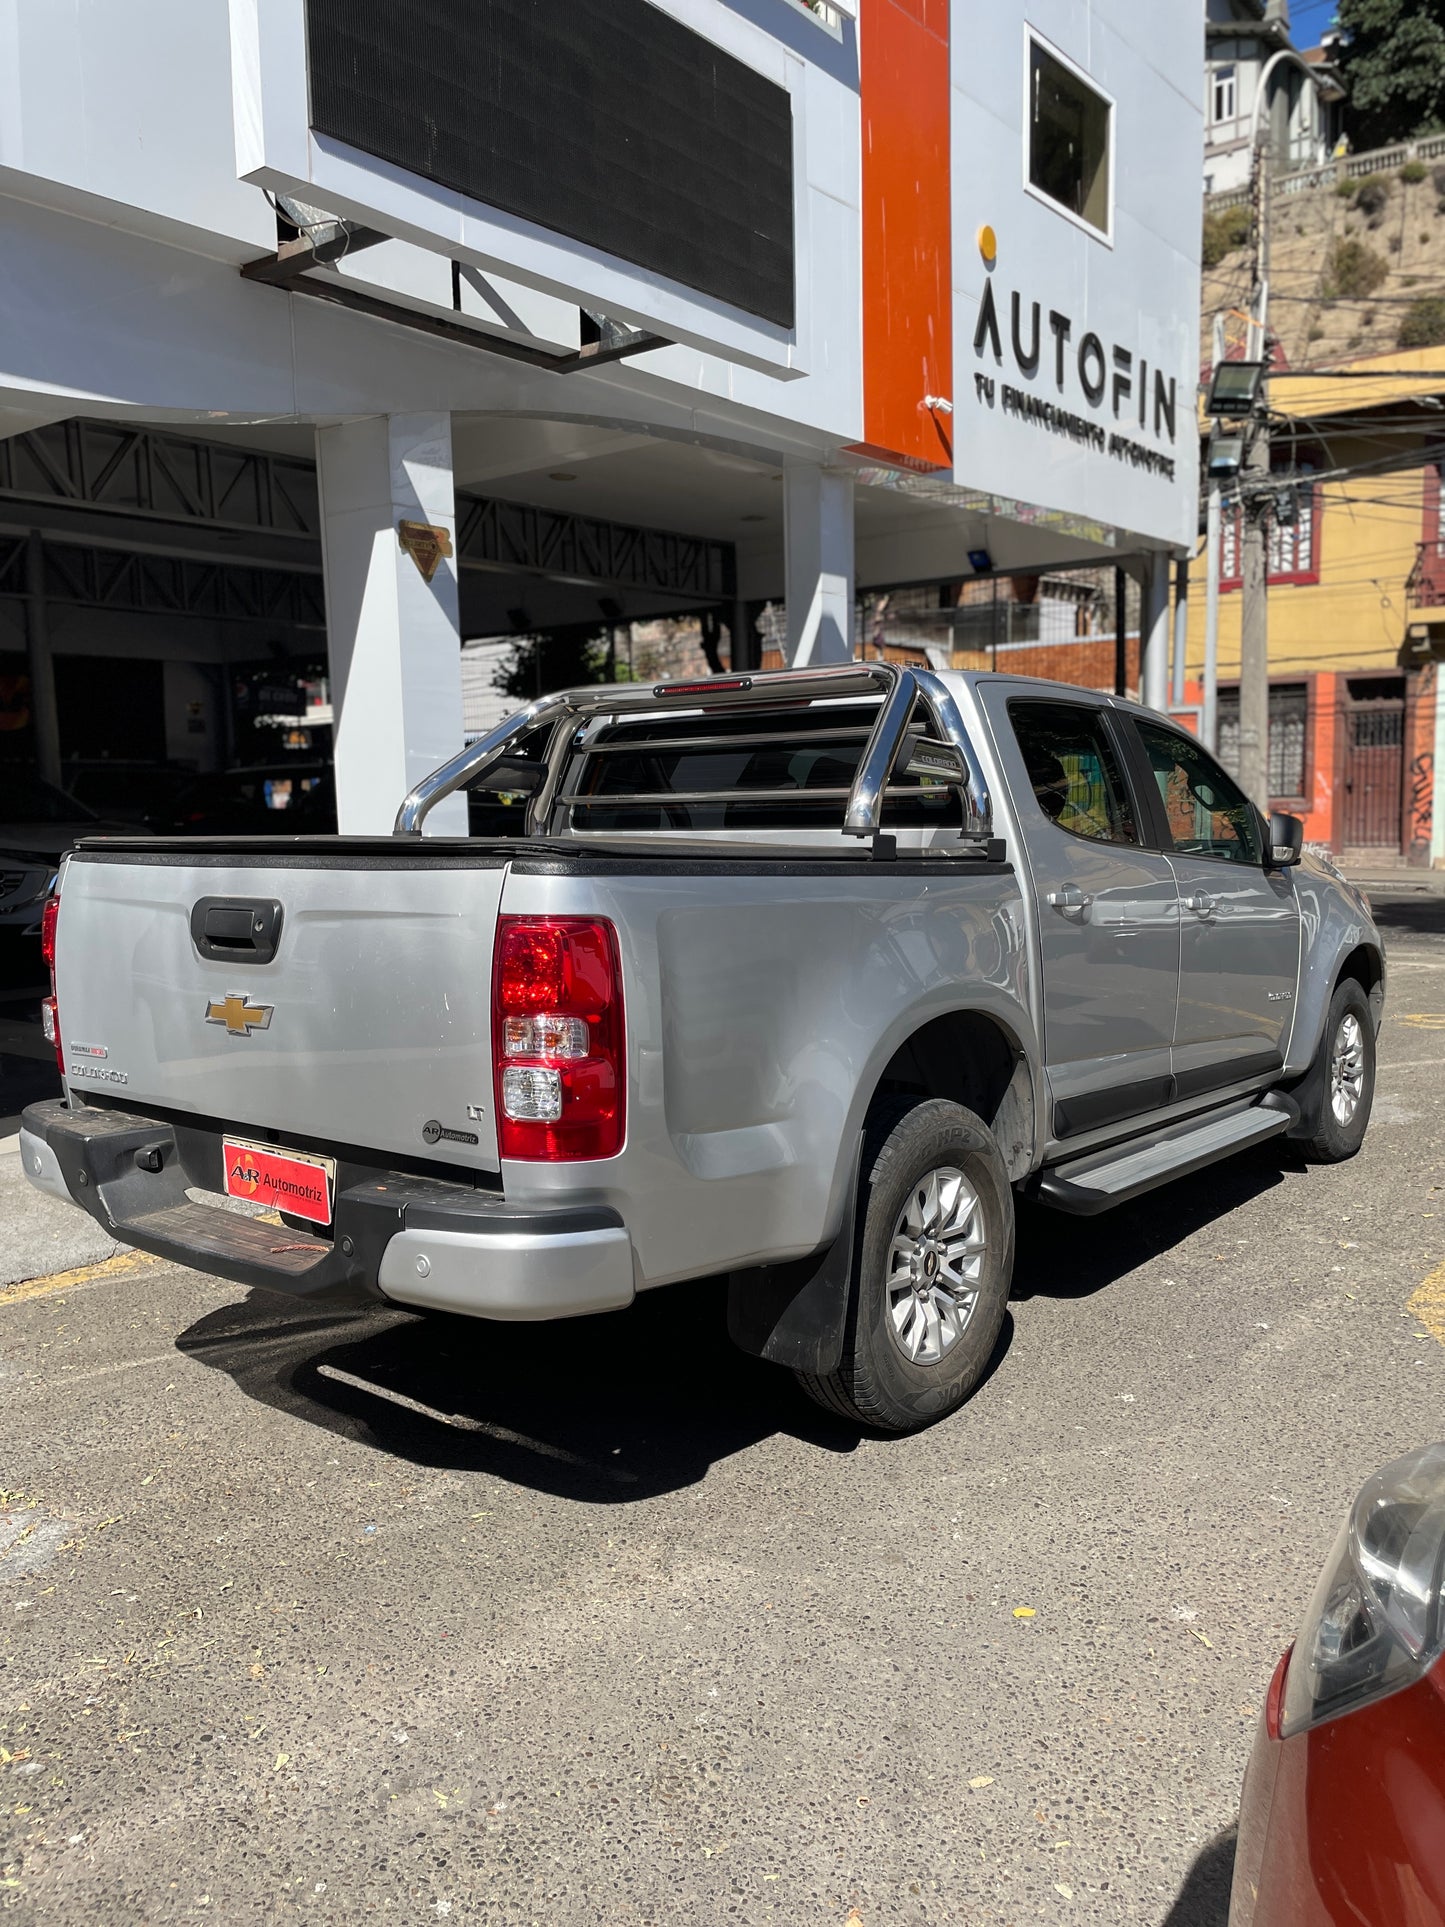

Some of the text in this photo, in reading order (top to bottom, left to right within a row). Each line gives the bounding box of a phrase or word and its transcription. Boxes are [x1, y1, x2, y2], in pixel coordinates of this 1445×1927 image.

[973, 276, 1176, 441] AUTOFIN
[974, 372, 995, 407] TU
[71, 1063, 128, 1085] COLORADO
[466, 1104, 485, 1121] LT
[440, 1128, 477, 1144] Automotriz
[262, 1173, 323, 1203] Automotriz
